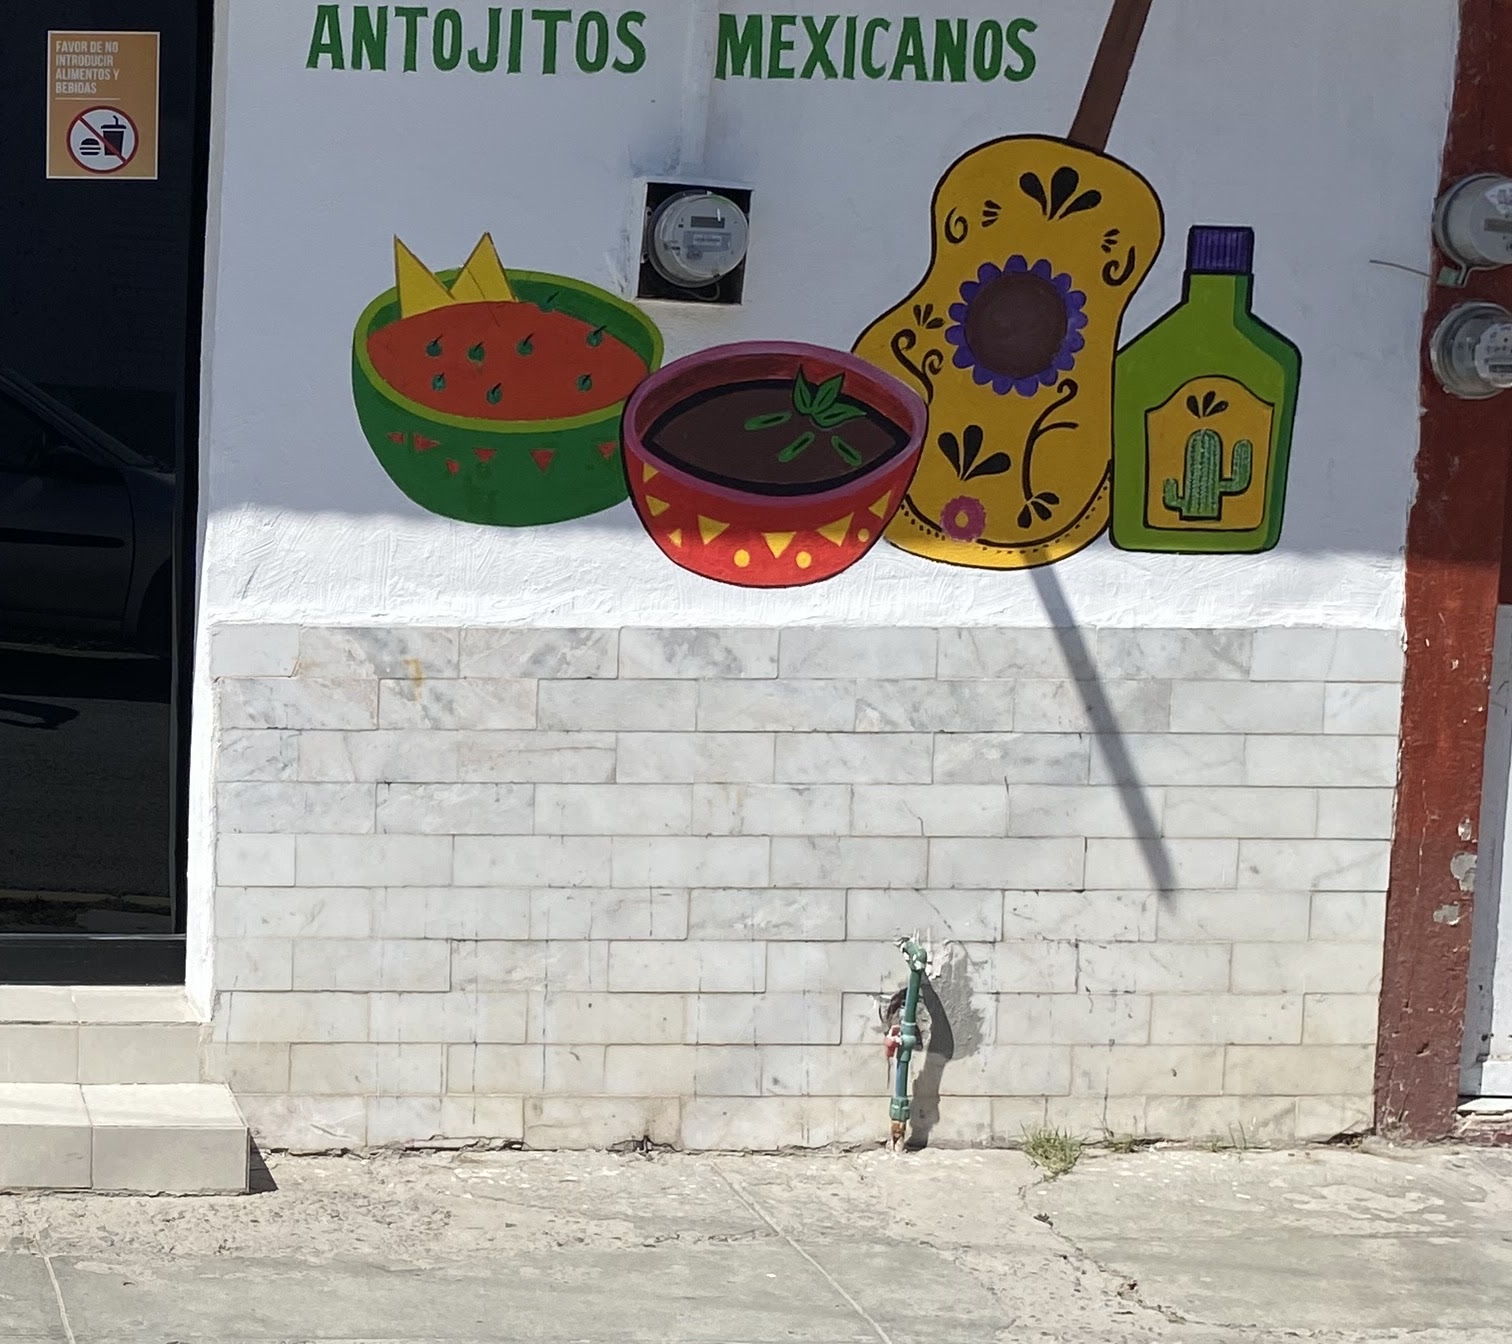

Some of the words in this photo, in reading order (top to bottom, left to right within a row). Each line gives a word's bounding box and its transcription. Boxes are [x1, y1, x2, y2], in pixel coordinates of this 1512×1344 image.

[55, 40, 88, 53] FAVOR
[90, 41, 103, 53] DE
[105, 41, 119, 53] NO
[304, 3, 648, 77] ANTOJITOS
[712, 12, 1039, 84] MEXICANOS
[55, 53, 114, 67] INTRODUCIR
[55, 67, 111, 80] ALIMENTOS
[113, 68, 120, 81] Y
[55, 81, 97, 94] BEBIDAS
